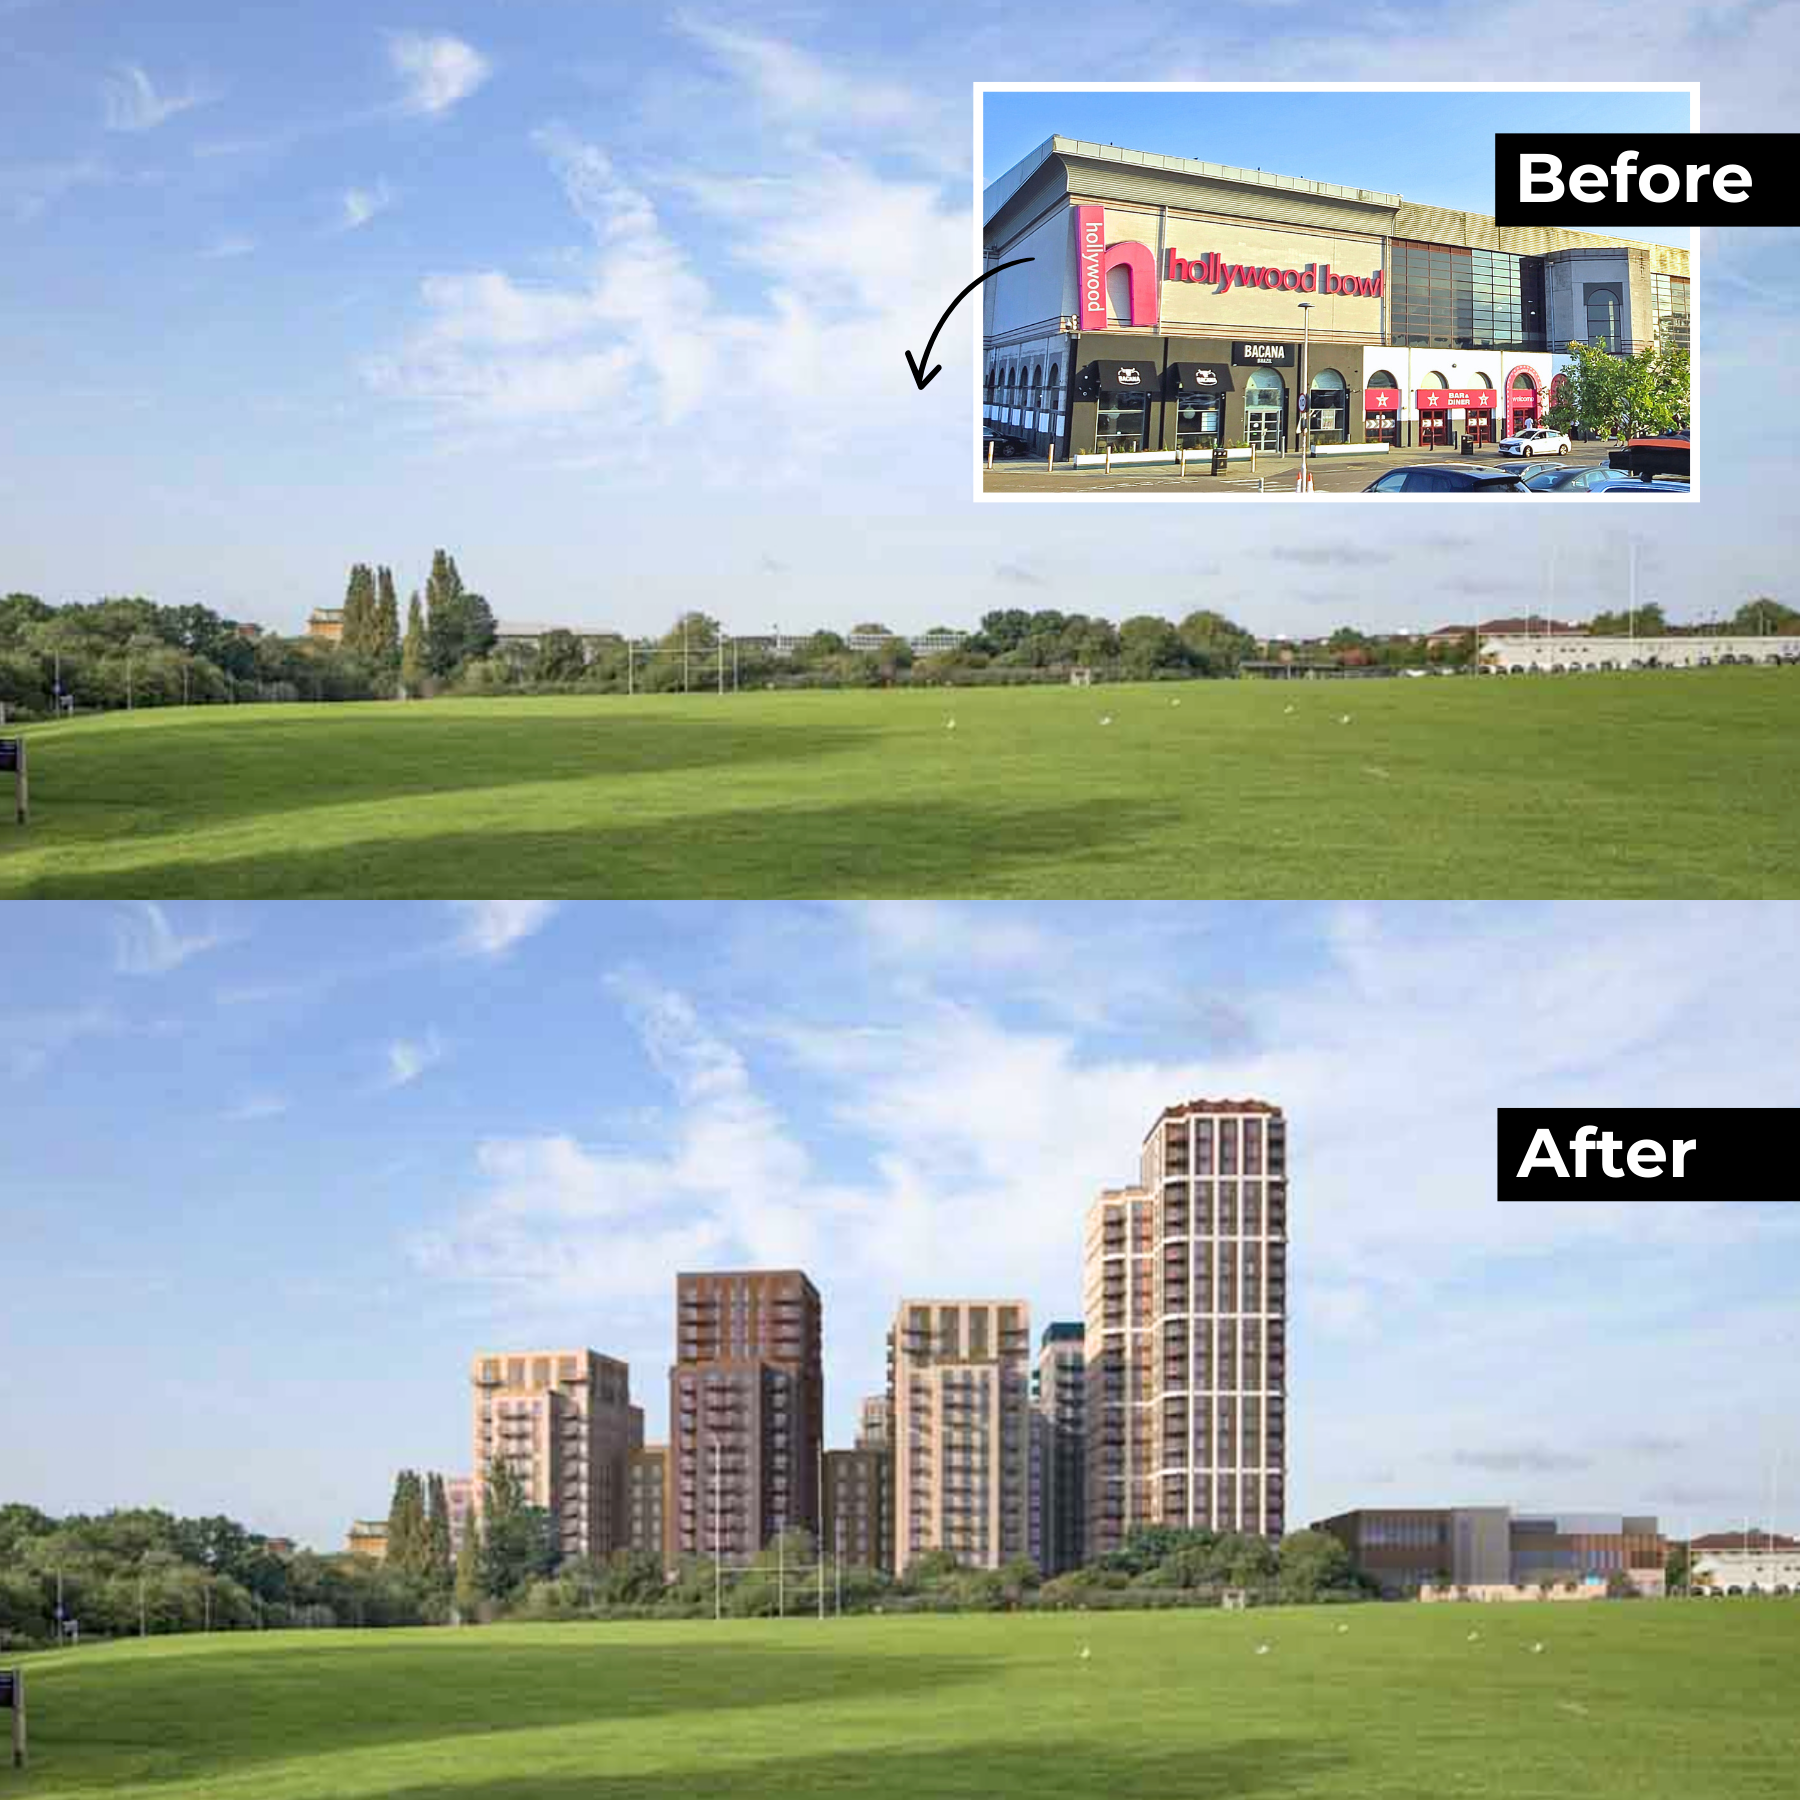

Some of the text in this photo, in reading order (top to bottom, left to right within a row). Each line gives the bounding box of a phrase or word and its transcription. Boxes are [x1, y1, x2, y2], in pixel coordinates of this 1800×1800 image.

[1082, 222, 1105, 312] hollywood
[1168, 247, 1384, 298] hollywood bowl
[1244, 344, 1285, 359] BACANA
